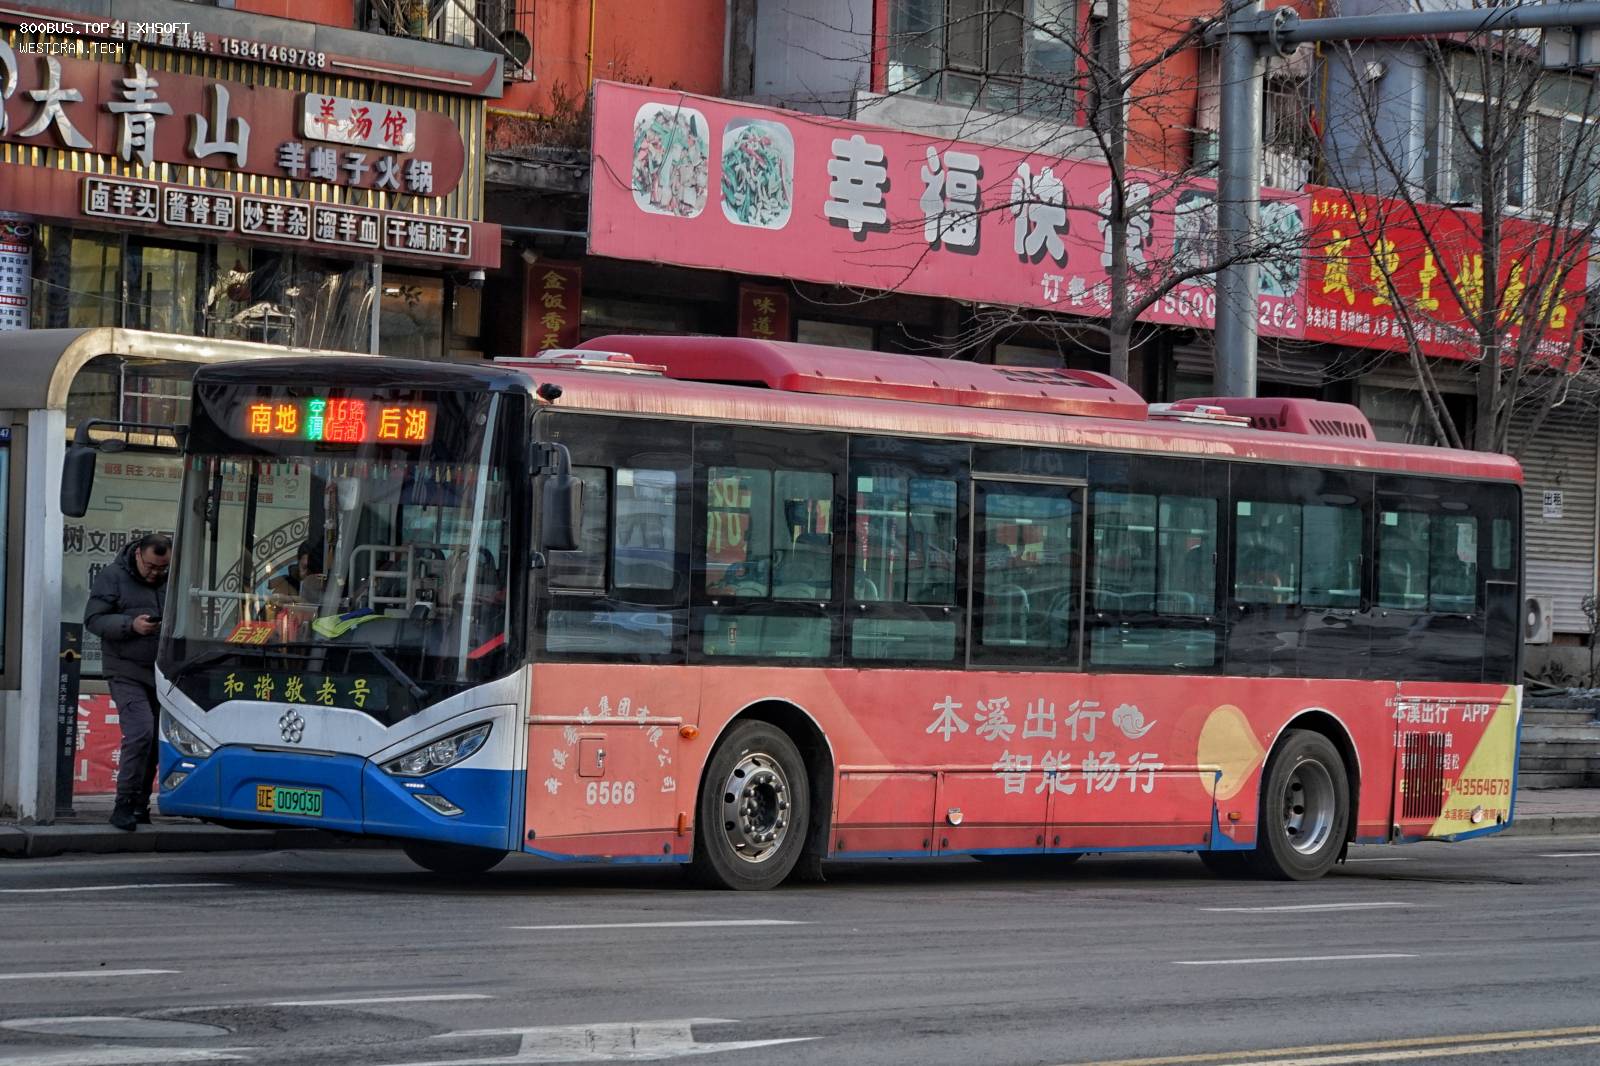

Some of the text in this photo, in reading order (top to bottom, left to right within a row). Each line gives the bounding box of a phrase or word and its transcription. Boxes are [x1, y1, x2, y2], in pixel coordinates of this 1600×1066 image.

[15, 55, 251, 168] 大青山
[314, 97, 408, 147] 羊汤馆
[278, 141, 434, 193] 羊蝎子火锅
[90, 182, 157, 218] 卤羊头
[168, 191, 233, 227] 酱脊骨
[243, 201, 309, 236] 炒羊杂
[388, 219, 468, 254] 干煸肺子
[824, 134, 1152, 272] 幸福快餐
[752, 296, 777, 340] 味道
[251, 403, 298, 434] 南地
[327, 399, 366, 422] 16路
[378, 407, 427, 441] 后湖
[1544, 492, 1563, 506] 出租
[63, 524, 175, 553] 树文明
[229, 626, 273, 645] 后湖
[224, 673, 371, 708] 和谐敬老号
[926, 695, 1106, 742] 本溪出行
[1462, 703, 1490, 723] APP
[586, 781, 636, 805] 6566
[991, 750, 1165, 795] 智能畅行
